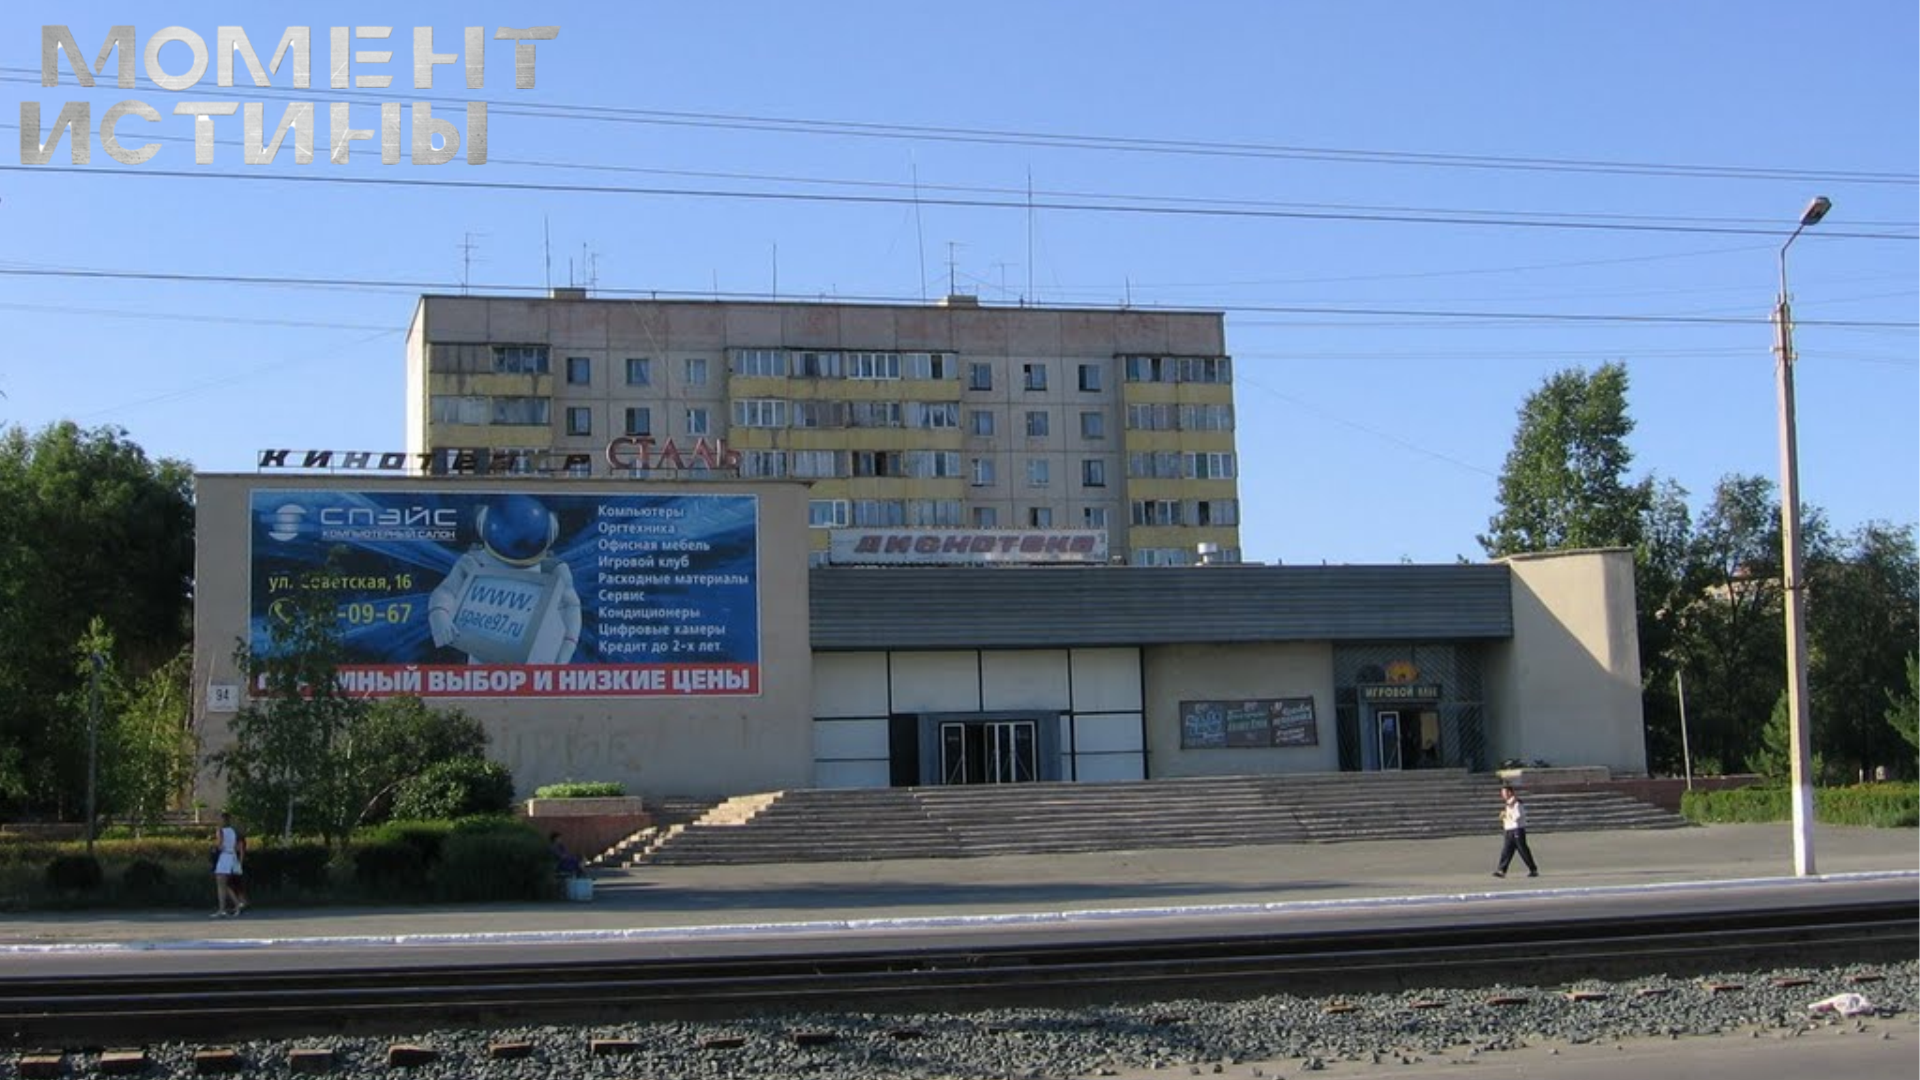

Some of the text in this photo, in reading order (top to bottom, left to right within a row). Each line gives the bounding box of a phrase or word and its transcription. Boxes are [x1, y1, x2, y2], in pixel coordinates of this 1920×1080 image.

[259, 437, 740, 471] КИНОТЕАР СТАЛЬ
[321, 506, 457, 526] СПЭЙС
[598, 505, 684, 518] Компьютеры
[322, 529, 456, 540] КОМПЬЮТЕРНЫЙ САЛОН
[598, 522, 675, 535] Оргтехника
[598, 538, 710, 552] Офисная мебель
[598, 555, 690, 570] Игровой клуб
[268, 576, 294, 593] ул.
[395, 575, 412, 590] 16
[598, 573, 749, 587] Расходные материалы
[471, 586, 533, 612] www.
[598, 590, 645, 603] Сервис
[598, 606, 700, 620] Кондиционеры
[459, 608, 525, 638] space97.ru
[598, 623, 726, 638] Цифровые камеры
[598, 640, 647, 655] Кредит
[651, 643, 669, 654] до
[672, 640, 695, 652] 2-х
[428, 671, 526, 692] ВЫБОР
[534, 671, 553, 692] И
[559, 671, 666, 691] НИЗКИЕ
[672, 670, 750, 693] ЦЕНЫ
[215, 689, 230, 701] 94
